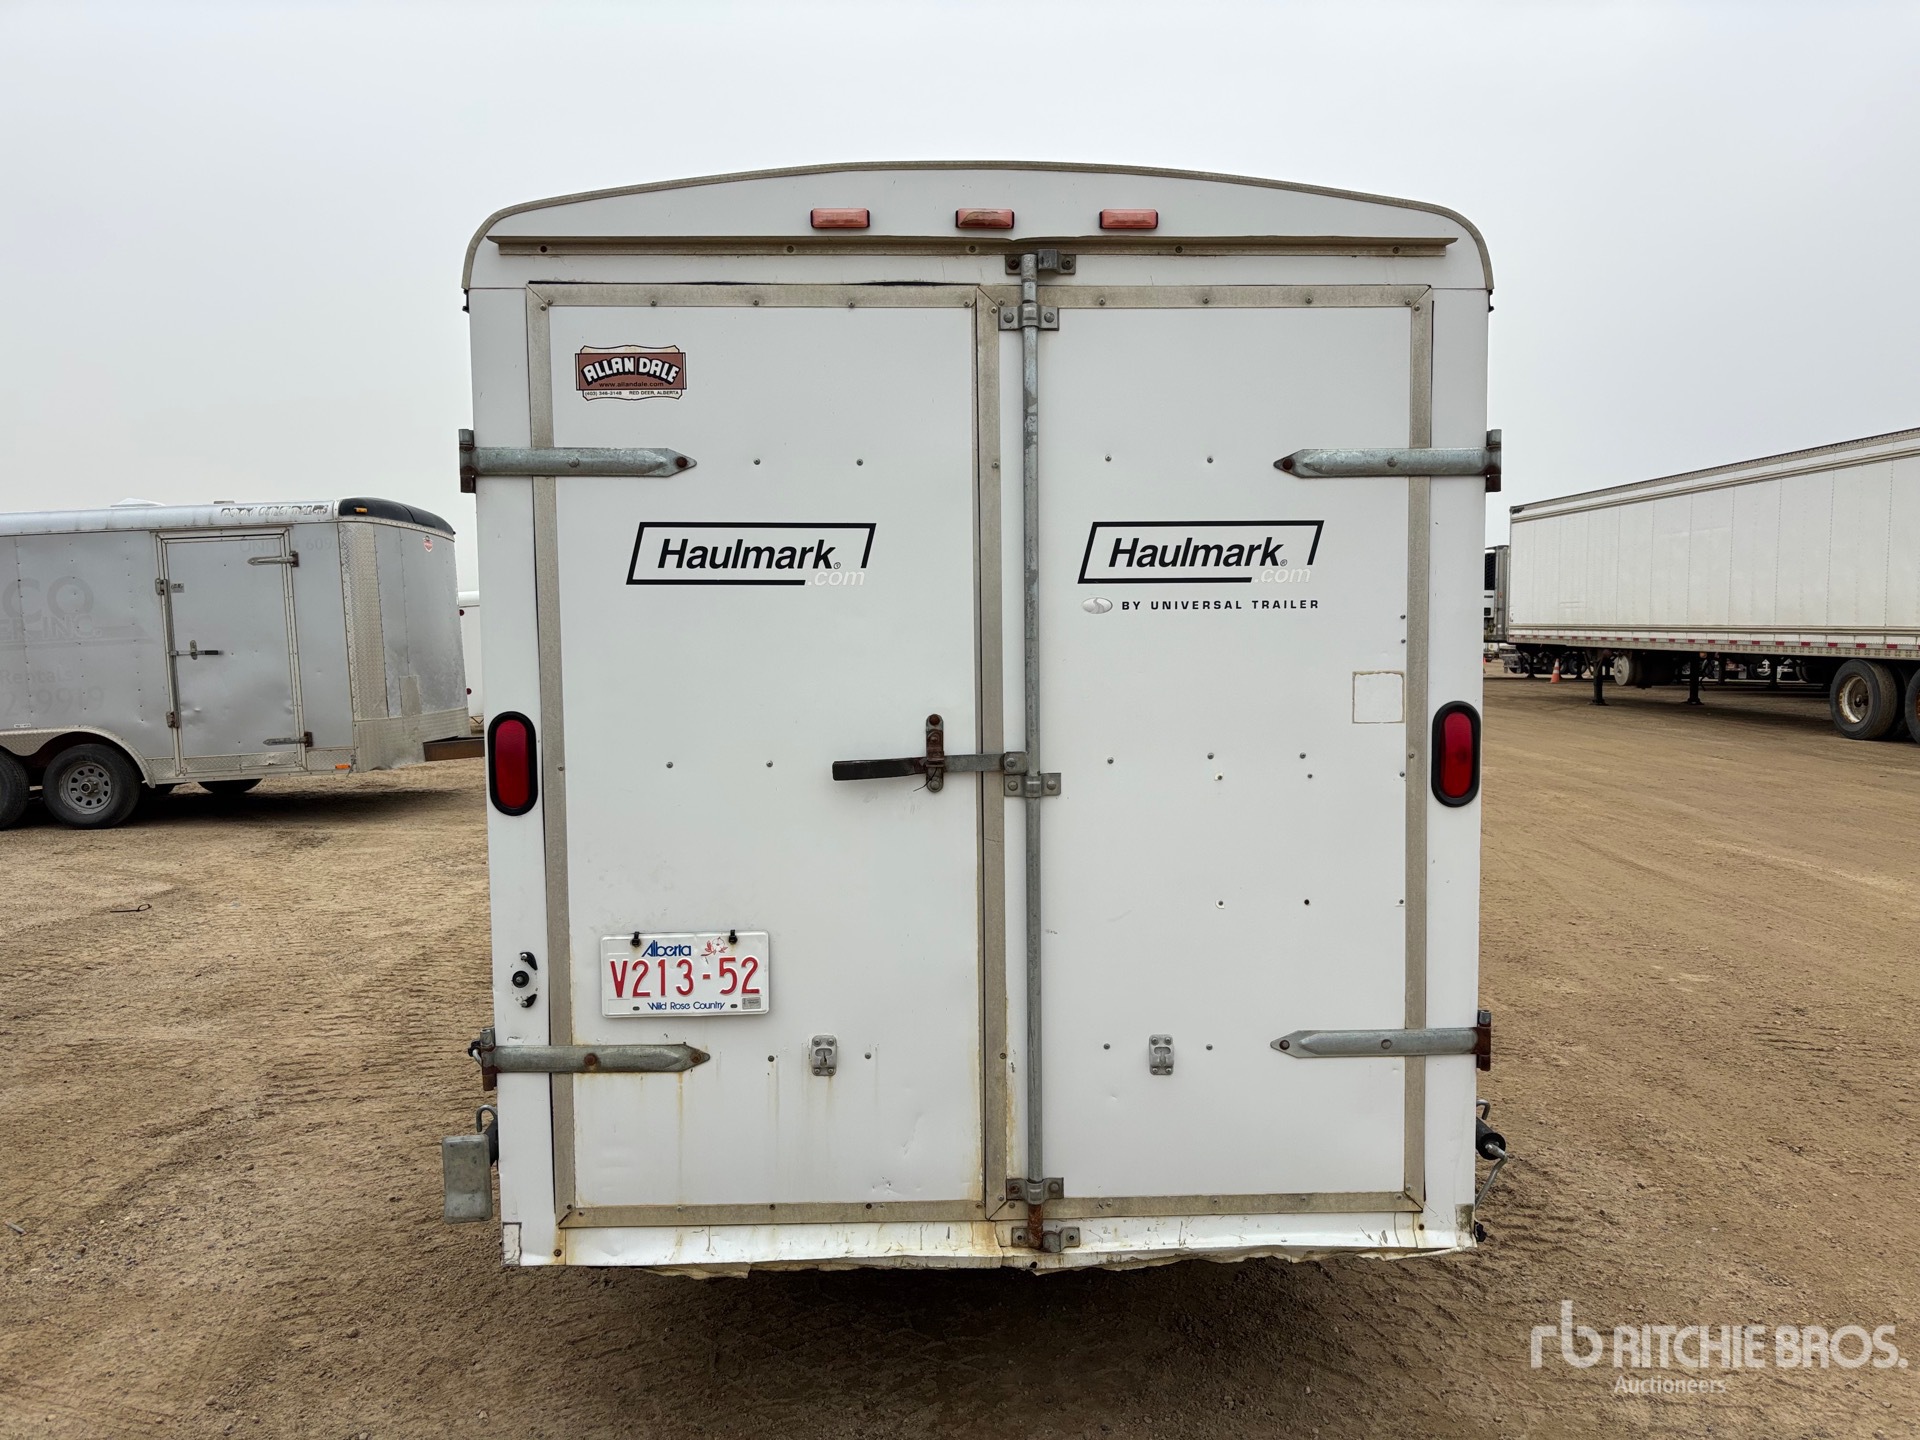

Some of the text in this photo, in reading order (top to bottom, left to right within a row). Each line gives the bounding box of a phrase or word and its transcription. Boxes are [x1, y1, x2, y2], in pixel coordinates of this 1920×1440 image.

[581, 356, 681, 386] ALLAN DALE
[657, 538, 836, 569] Haulmark
[1108, 536, 1284, 568] Haulmark
[806, 570, 865, 586] .com
[1253, 566, 1311, 583] .com
[1122, 599, 1319, 610] BY UNIVERSAL TRAILER
[641, 940, 692, 957] Alberta
[609, 956, 760, 998] V213-52
[647, 1001, 726, 1011] Wild Rose Country
